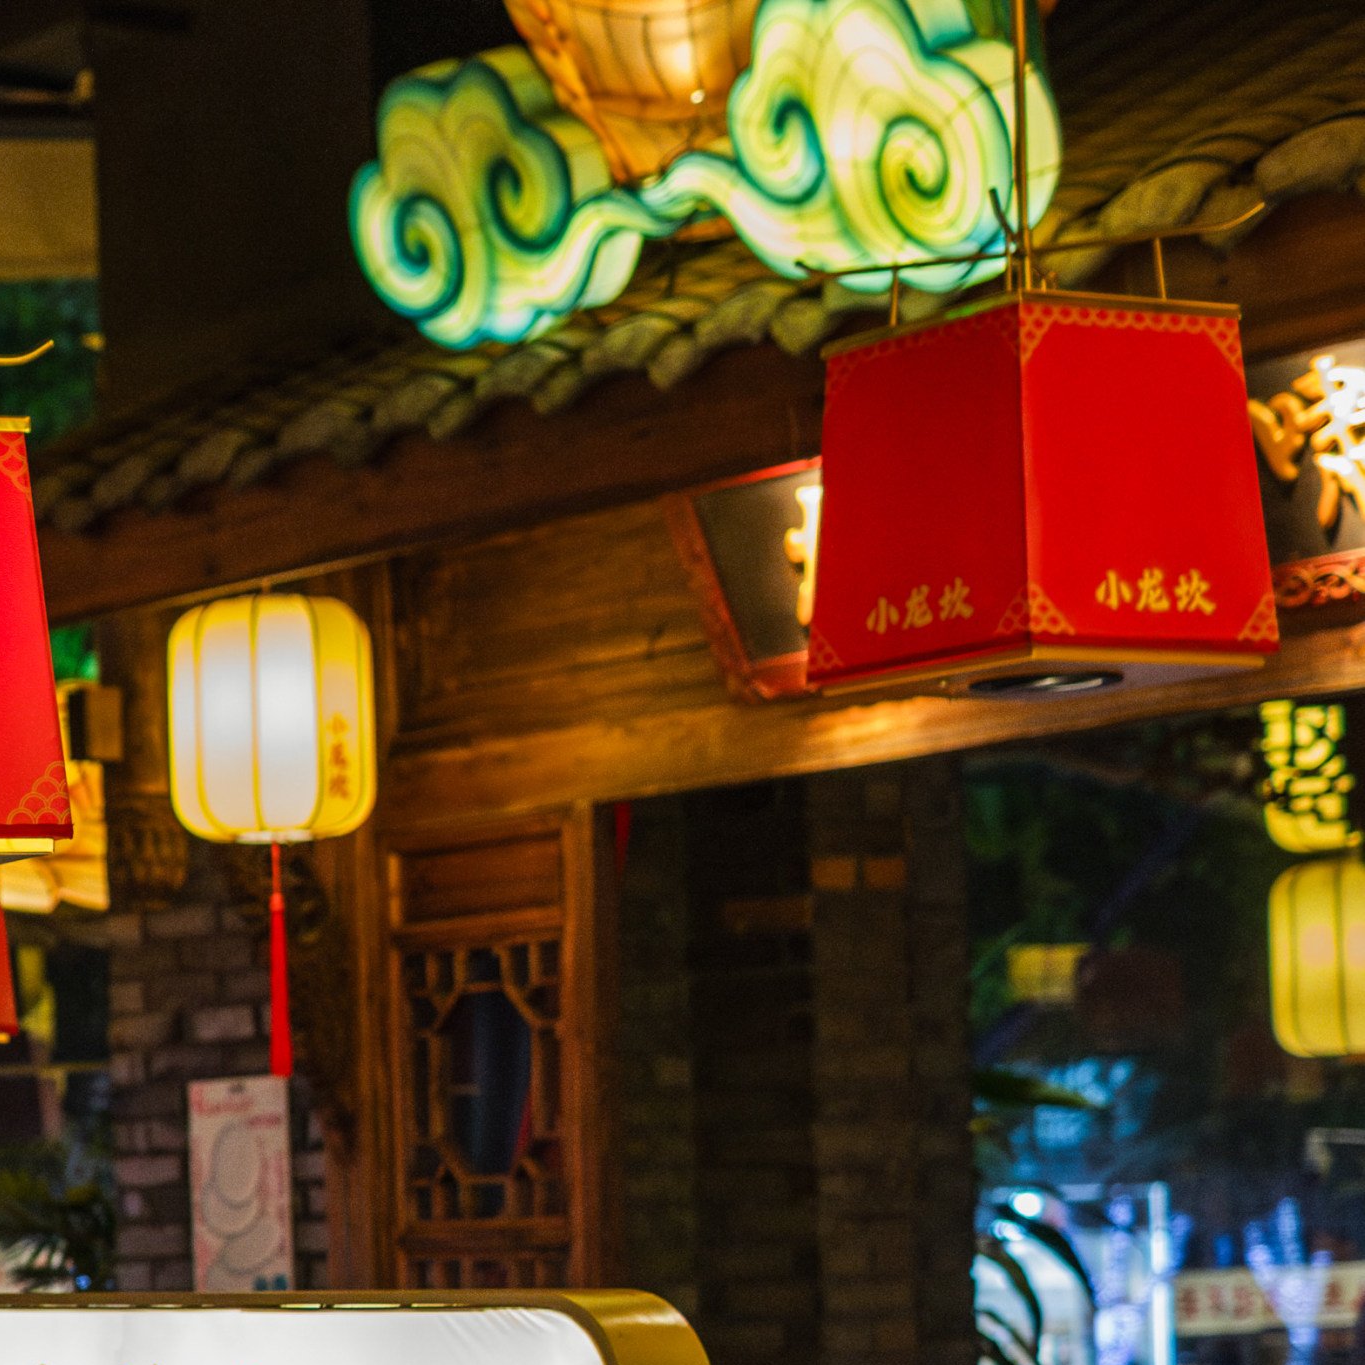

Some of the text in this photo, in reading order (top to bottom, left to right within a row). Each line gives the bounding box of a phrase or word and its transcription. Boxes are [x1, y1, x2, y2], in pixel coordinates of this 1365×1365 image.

[865, 577, 975, 634] 小龙坎
[1095, 568, 1218, 618] 小龙坎
